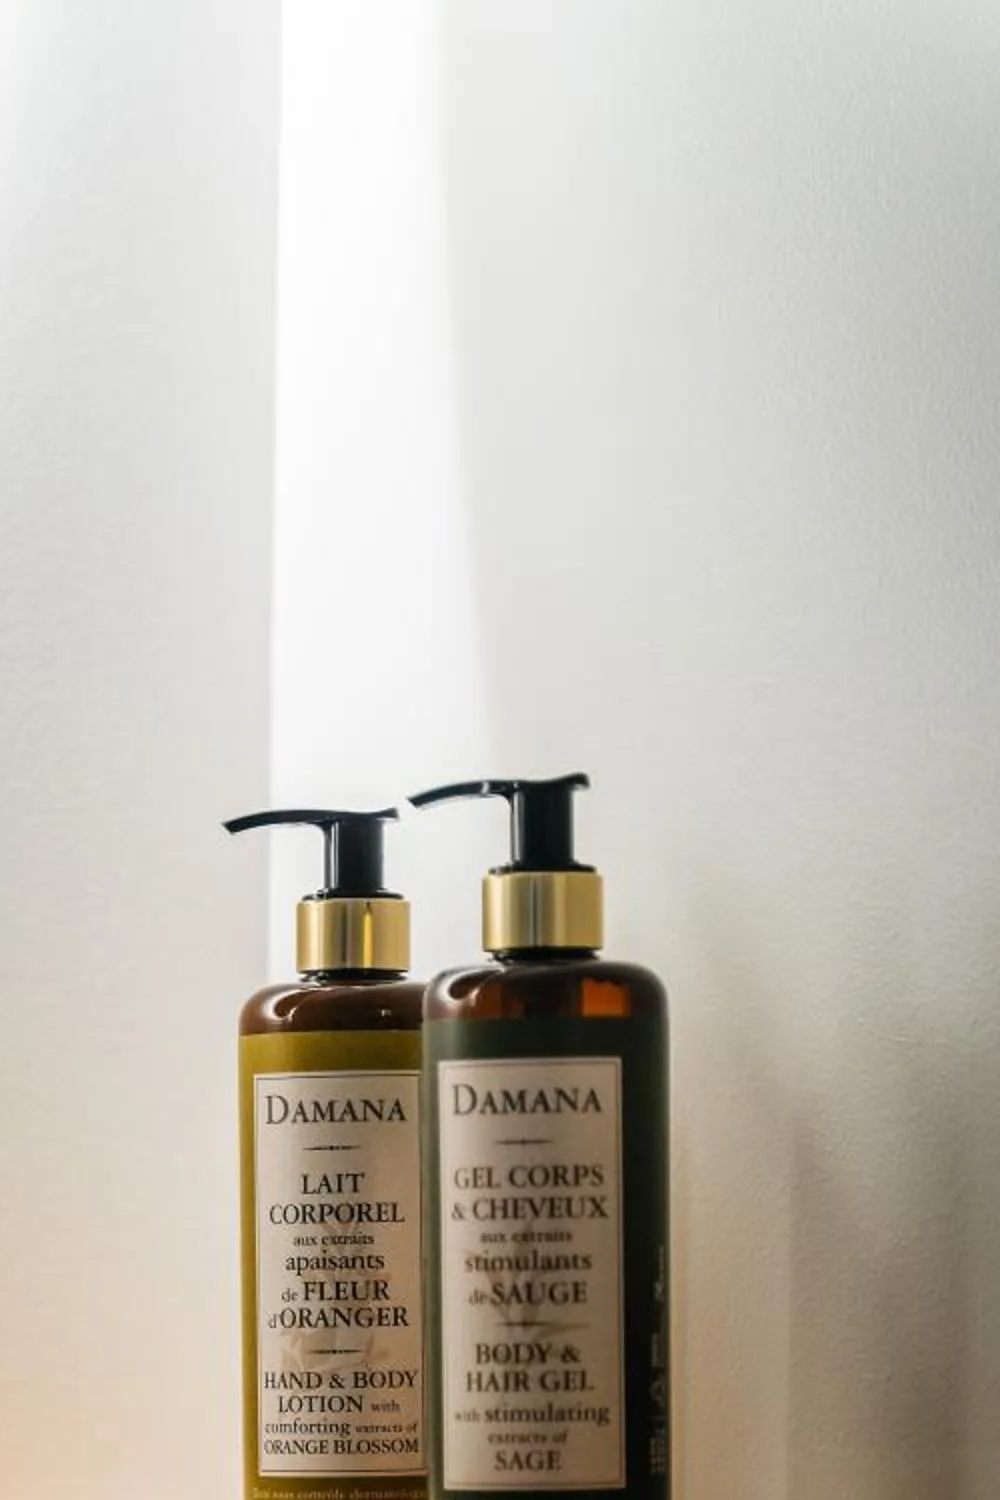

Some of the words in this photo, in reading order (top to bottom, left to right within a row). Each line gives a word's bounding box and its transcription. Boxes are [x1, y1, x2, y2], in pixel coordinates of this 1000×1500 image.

[265, 1095, 408, 1125] DAMANA
[452, 1083, 603, 1116] DAMANA
[301, 1172, 366, 1195] LAIT
[454, 1166, 501, 1190] GEL
[508, 1164, 605, 1189] CORPS
[269, 1202, 406, 1225] CORPOREL
[451, 1203, 465, 1221] &
[472, 1196, 609, 1221] CHEVEUX
[293, 1235, 317, 1246] aux
[321, 1231, 375, 1246] extraits
[285, 1250, 385, 1275] apaisants
[465, 1250, 593, 1273] stimulants
[281, 1287, 298, 1302] de
[303, 1280, 390, 1301] FLEUR
[491, 1281, 588, 1305] SAUGE
[475, 1343, 553, 1365] BODY
[560, 1344, 581, 1363] &
[264, 1371, 322, 1390] HAND
[329, 1372, 344, 1389] &
[353, 1369, 418, 1389] BODY
[466, 1370, 531, 1392] HAIR
[539, 1369, 596, 1392] GEL
[278, 1395, 364, 1414] LOTION
[371, 1400, 400, 1412] with
[484, 1403, 612, 1427] stimulating
[265, 1420, 351, 1438] comforting
[264, 1439, 329, 1455] ORANGE
[333, 1438, 419, 1454] BLOSSOM
[495, 1450, 562, 1472] SAGE
